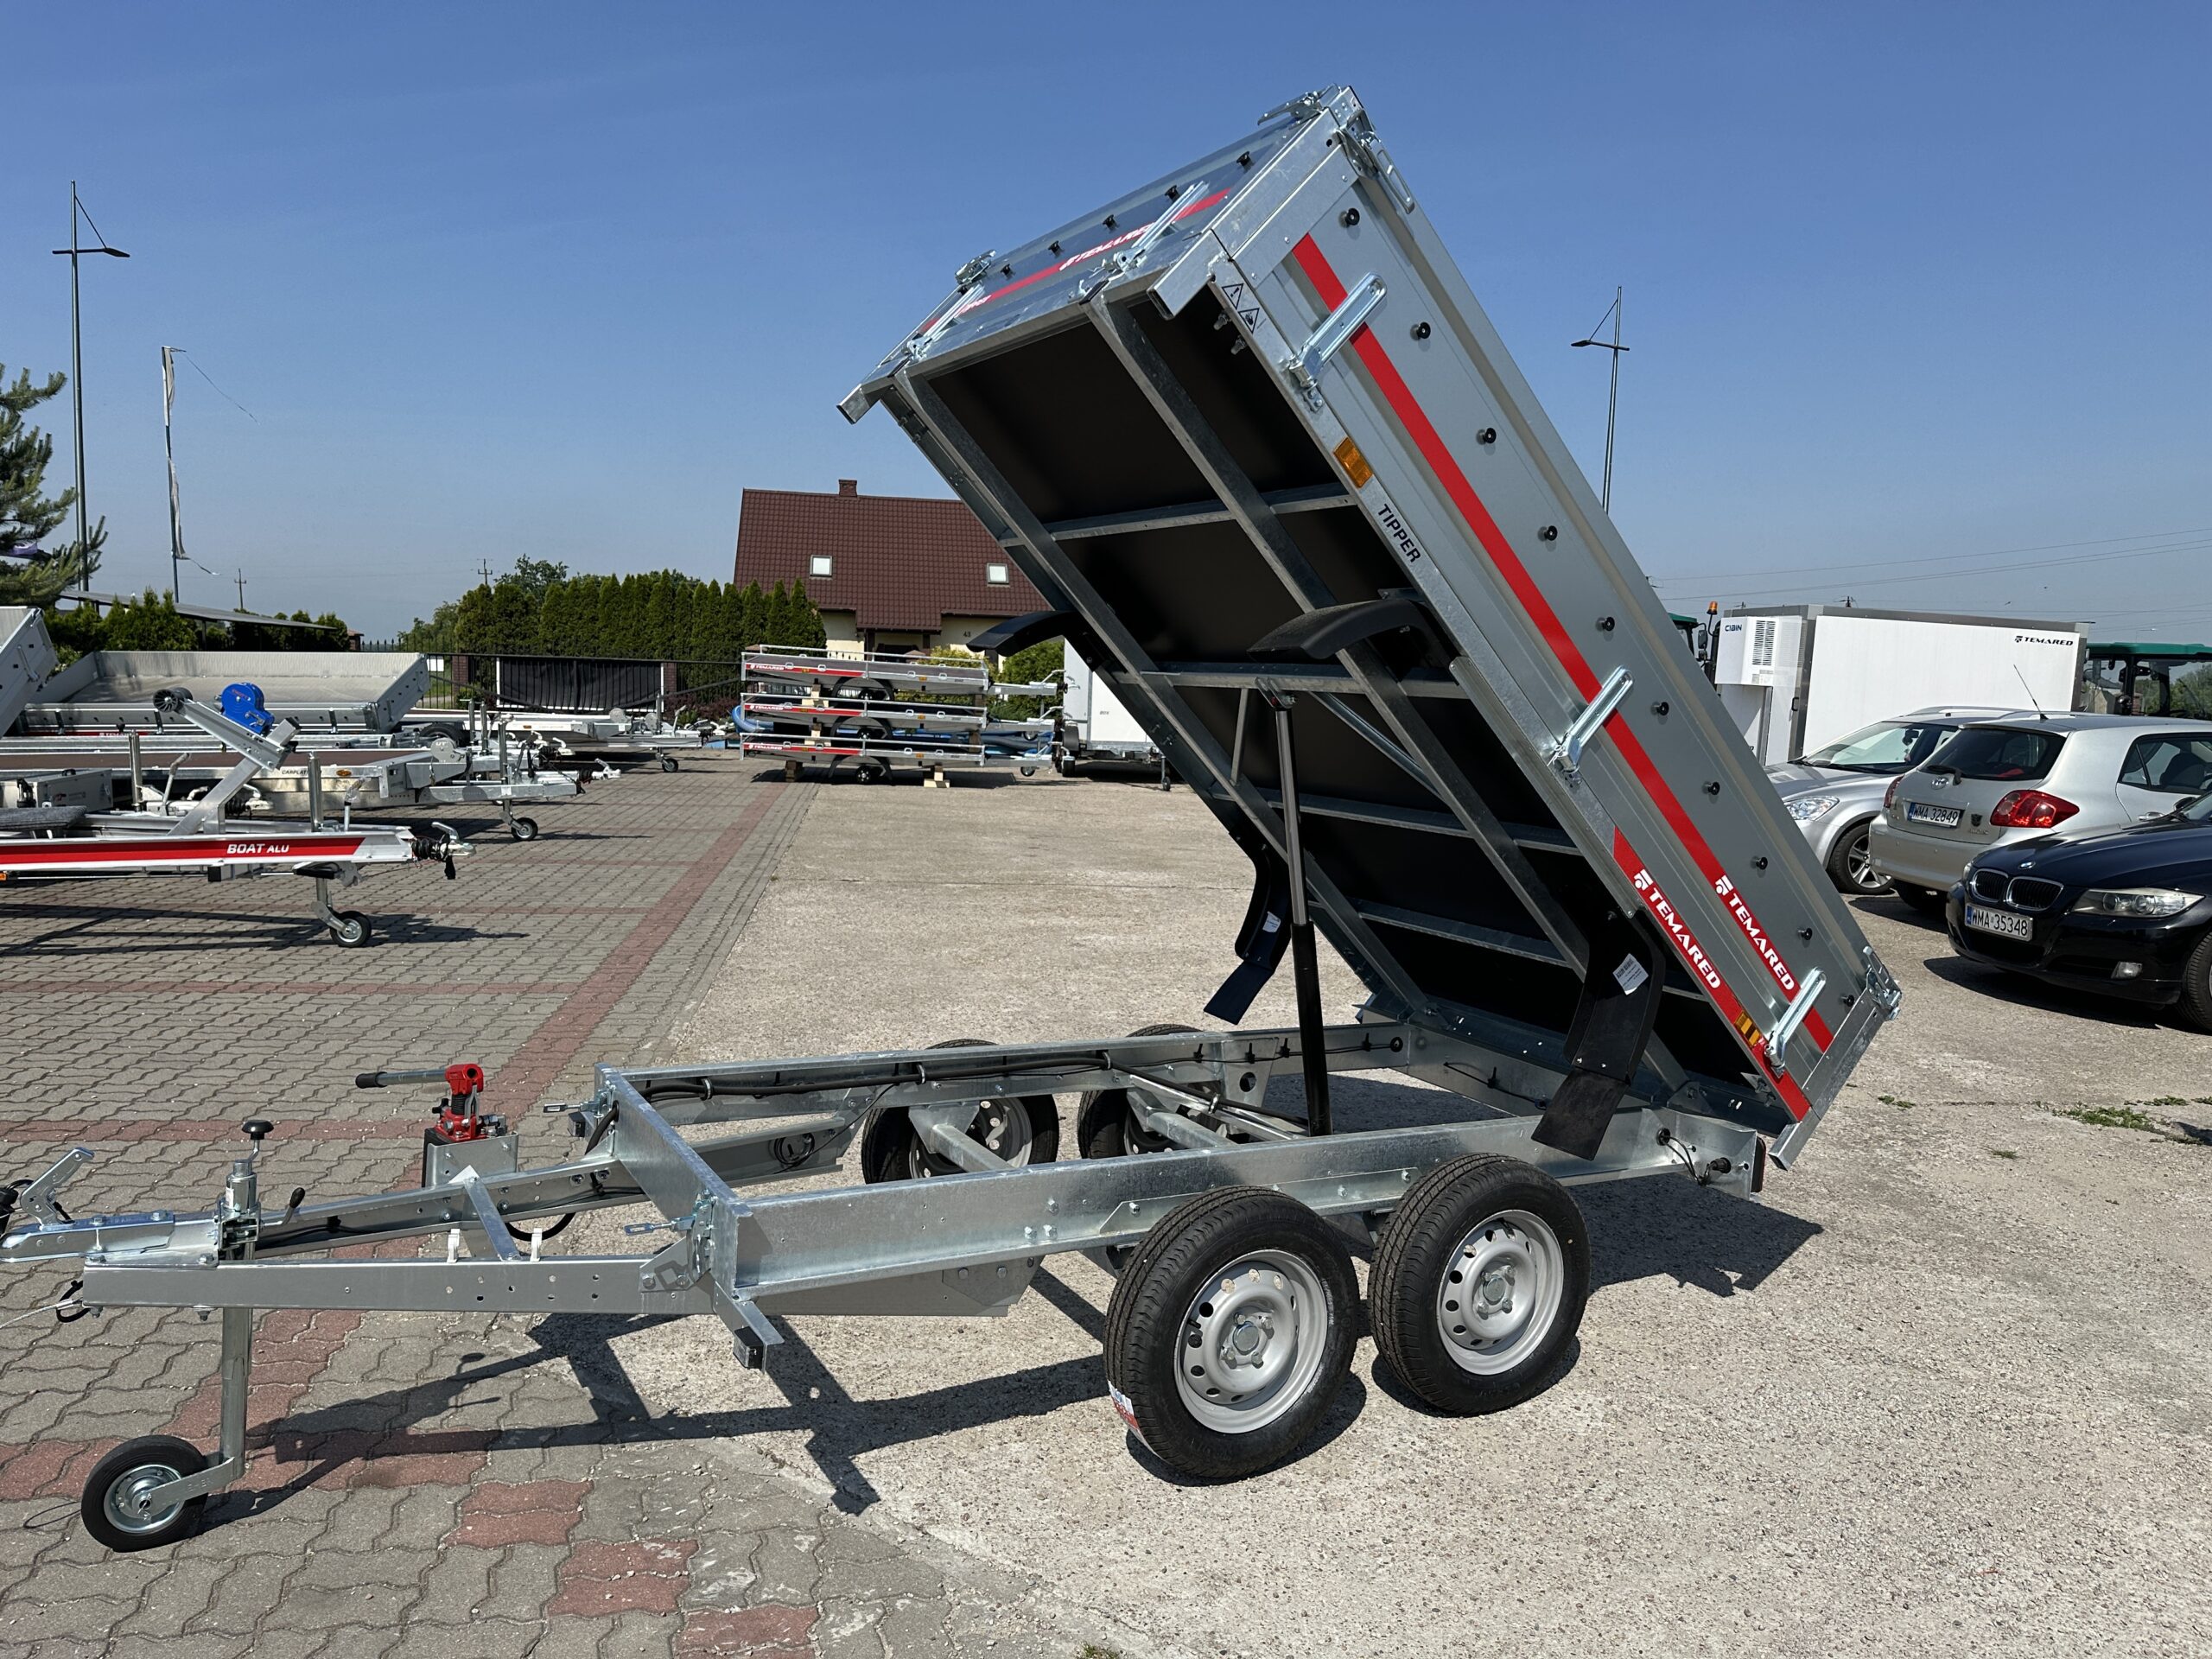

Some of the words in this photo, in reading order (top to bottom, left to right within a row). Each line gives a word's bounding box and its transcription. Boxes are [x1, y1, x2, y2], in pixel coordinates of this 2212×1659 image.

[1377, 503, 1421, 563] TIPPER
[2024, 636, 2074, 646] TEMARED
[1913, 804, 1929, 819] WMA
[1930, 808, 1959, 823] 32849
[226, 843, 265, 855] BOAT
[266, 845, 289, 854] ALU
[1972, 907, 1990, 928] WMA
[1993, 913, 2028, 937] 35348
[1649, 887, 1721, 988] TEMARED
[1728, 893, 1795, 990] TEMARED
